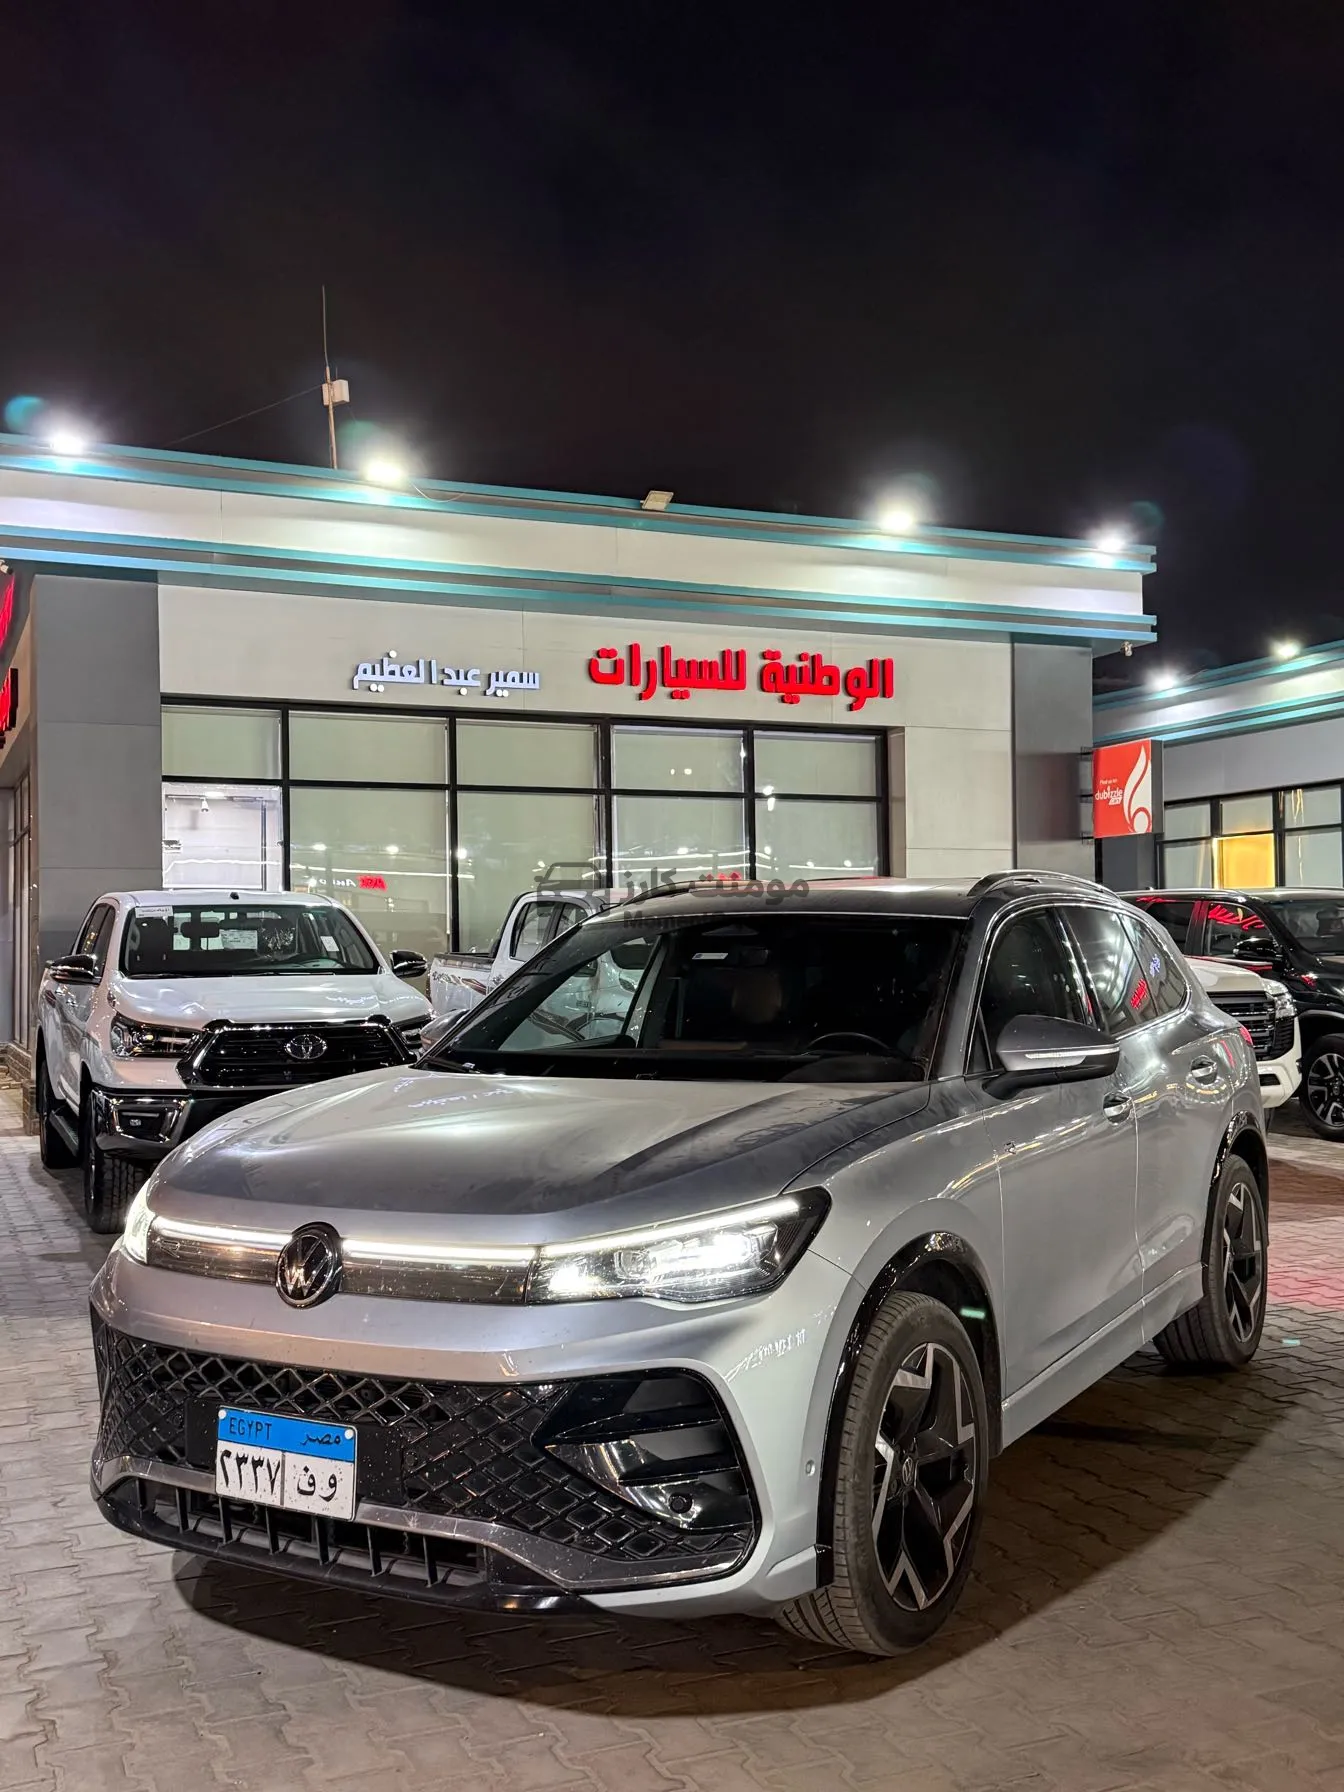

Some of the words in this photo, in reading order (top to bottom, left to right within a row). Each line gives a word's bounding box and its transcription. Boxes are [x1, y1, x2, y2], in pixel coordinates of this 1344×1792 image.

[442, 667, 481, 696] عبد
[485, 670, 540, 697] سمير
[588, 642, 747, 700] للسيارات
[760, 648, 894, 711] الوطنية
[1094, 785, 1123, 801] dubizzle
[229, 1417, 273, 1441] EGYPT
[302, 1433, 341, 1446] مصر
[220, 1449, 281, 1496] ٢٣٣٧
